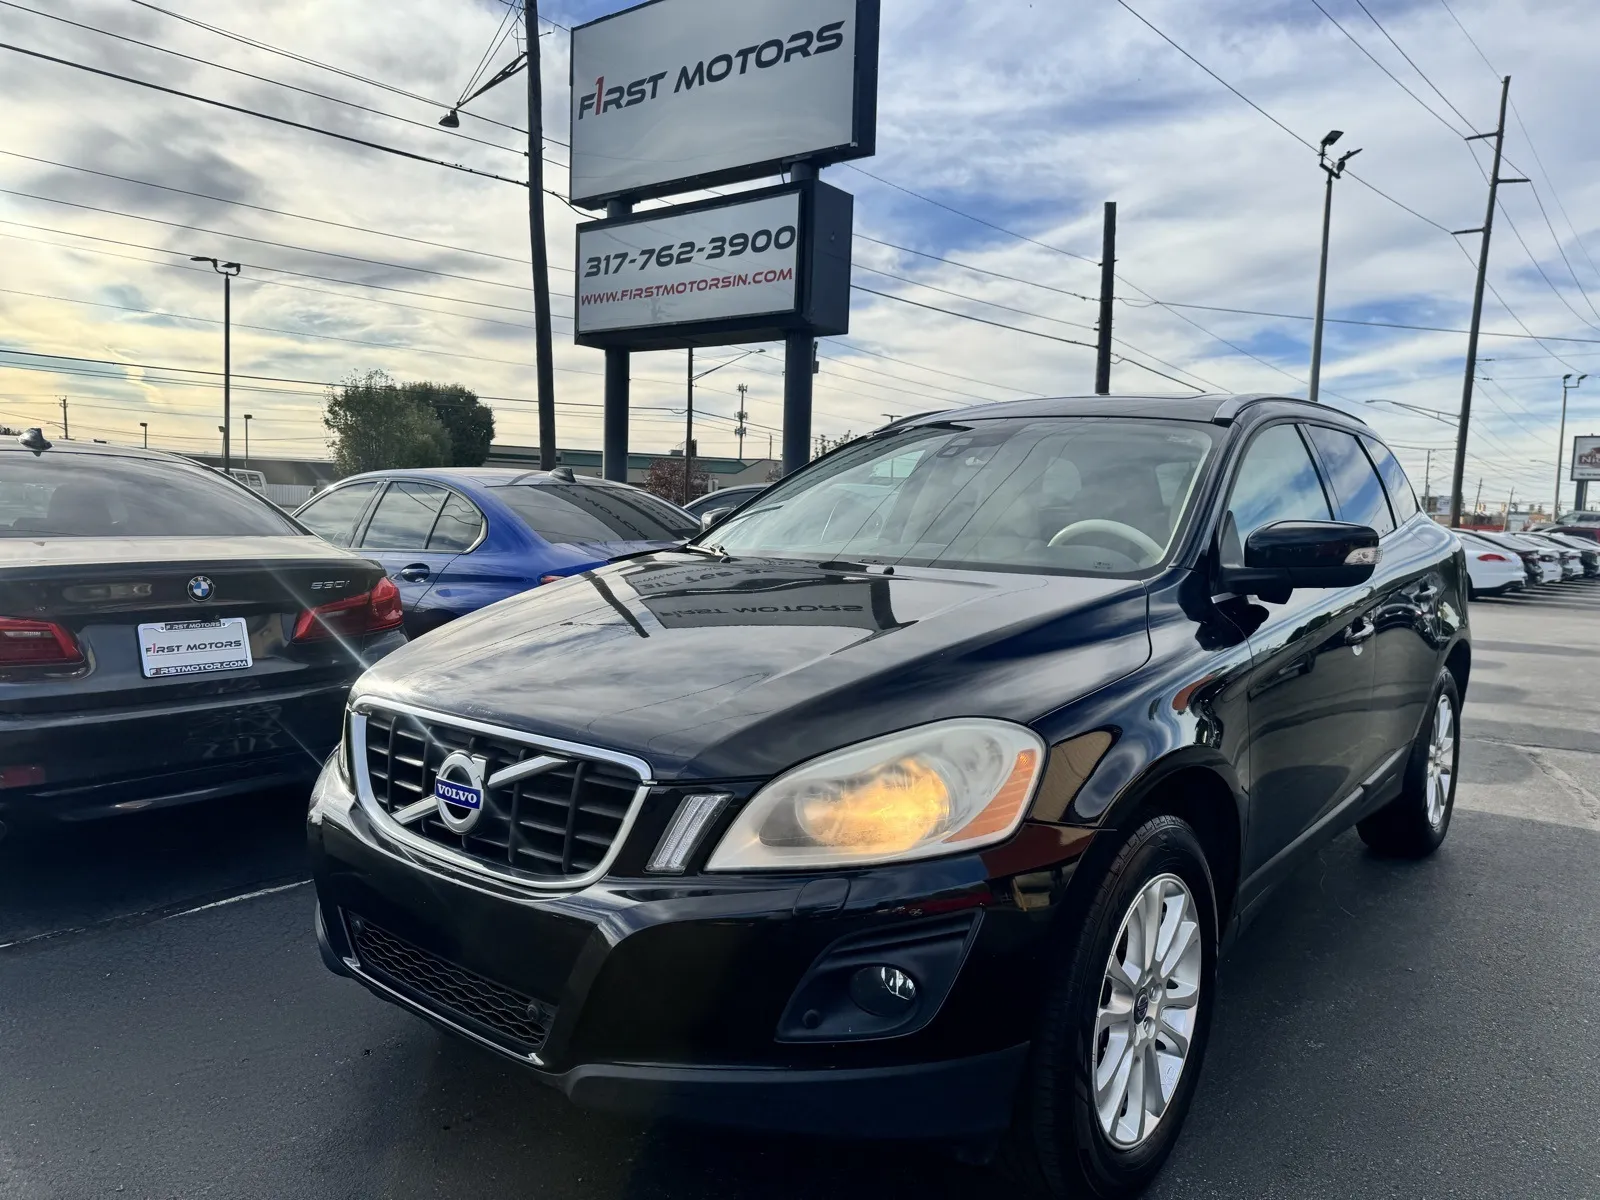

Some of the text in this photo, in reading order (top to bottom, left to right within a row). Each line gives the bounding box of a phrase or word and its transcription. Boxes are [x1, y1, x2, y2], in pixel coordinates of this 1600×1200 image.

[673, 20, 846, 94] MOTORS
[584, 225, 796, 278] 317-762-3900
[581, 267, 793, 306] WWW.FIRSTMOTORSIN.COM
[189, 621, 221, 629] MOTORS
[186, 640, 242, 651] MOTORS
[437, 783, 477, 804] VOLVO
